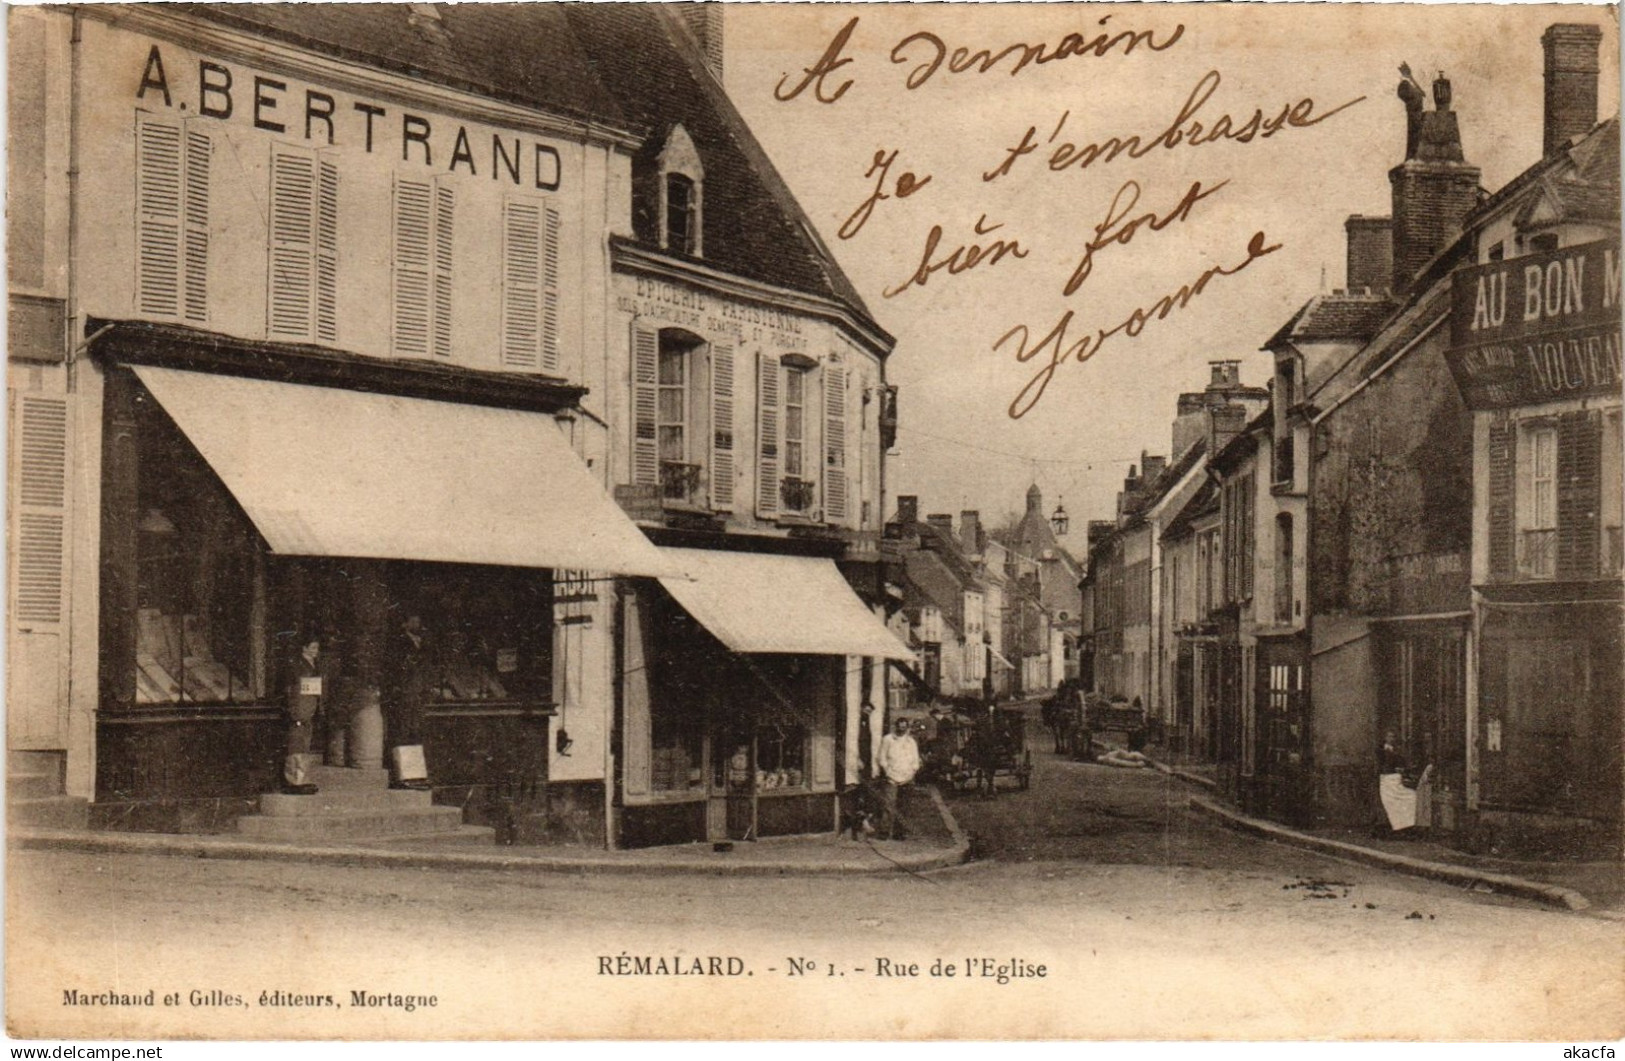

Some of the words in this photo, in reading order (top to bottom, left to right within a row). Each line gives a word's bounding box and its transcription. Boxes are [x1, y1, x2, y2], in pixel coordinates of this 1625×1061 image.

[774, 17, 858, 104] A
[838, 150, 931, 239] Je
[983, 71, 1367, 182] t'embrasse
[1064, 179, 1231, 297] fort
[636, 275, 705, 312] EPICERIE
[722, 303, 802, 335] PARISIENNE
[993, 232, 1283, 419] Yvonne
[1470, 271, 1507, 330] AU
[1523, 256, 1586, 322] BON
[62, 989, 155, 1008] Marchand
[163, 990, 181, 1008] et
[259, 989, 342, 1010] éditeurs,
[350, 989, 439, 1013] Mortagne
[598, 951, 754, 977] RÉMALARD.
[875, 957, 920, 977] Rue
[930, 957, 957, 977] de
[966, 957, 1048, 984] l'Eglise
